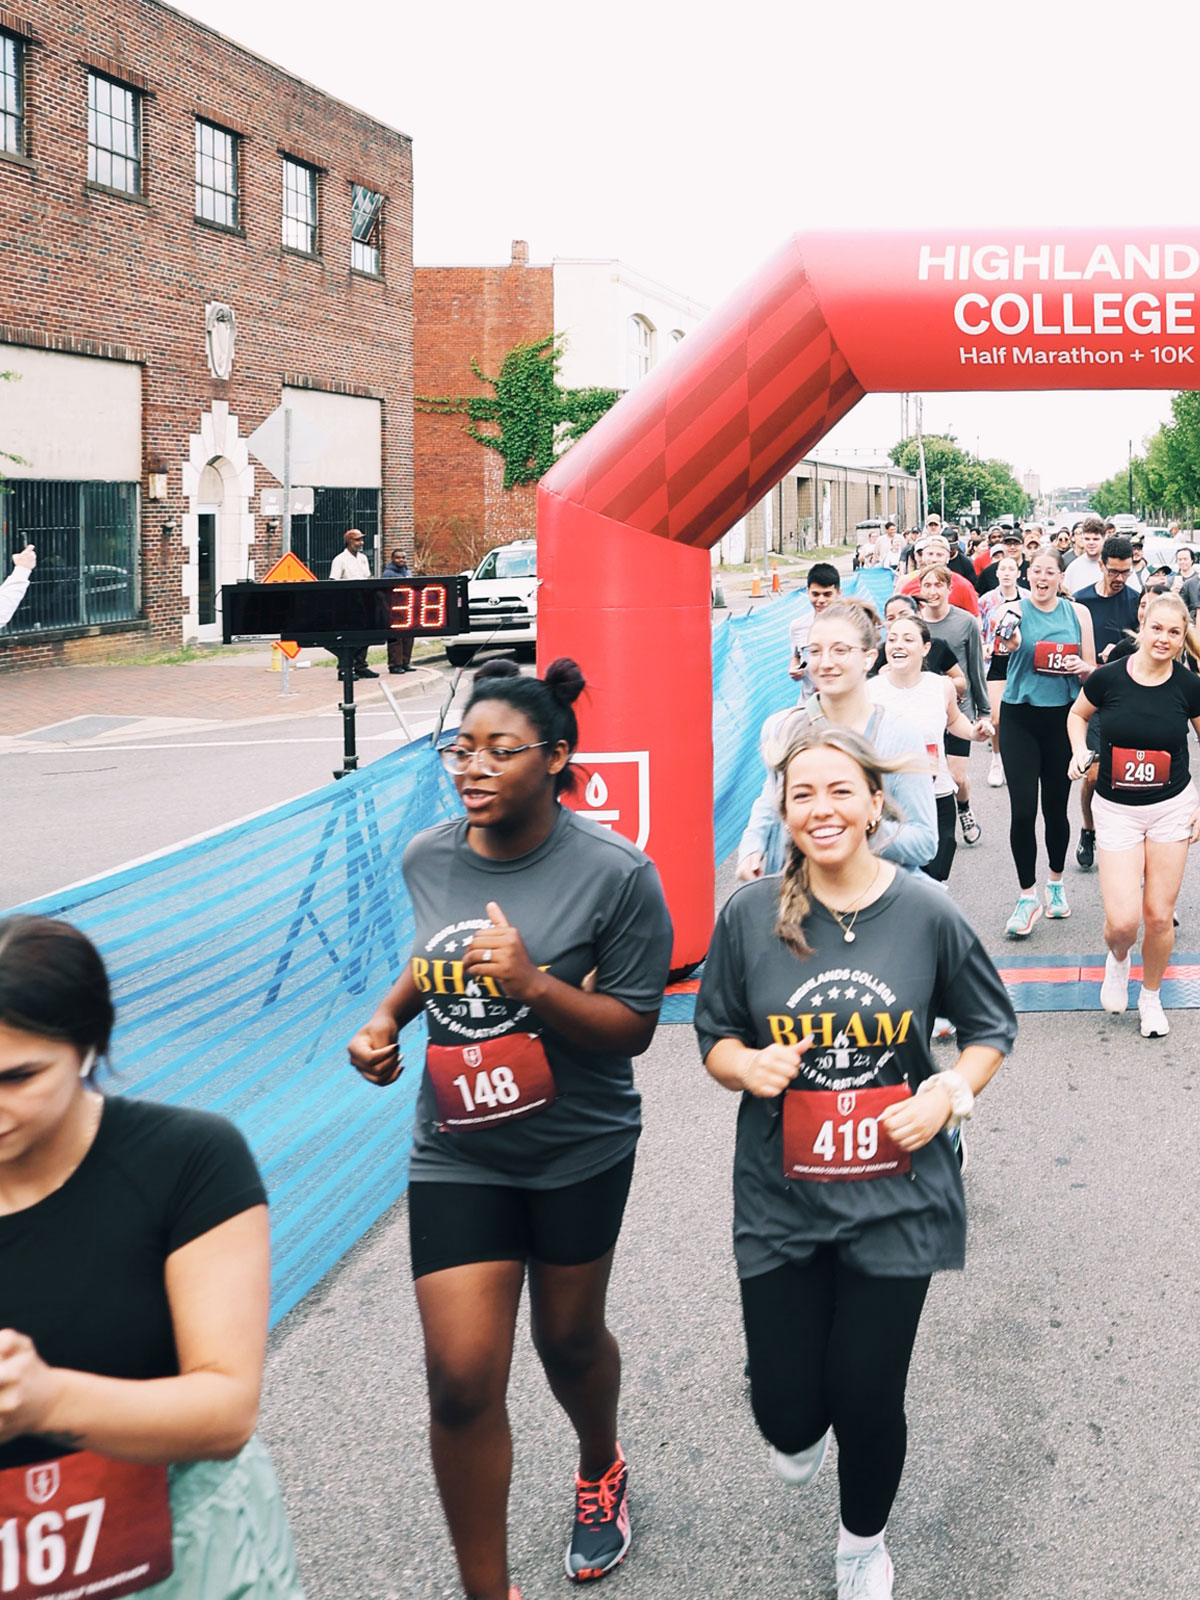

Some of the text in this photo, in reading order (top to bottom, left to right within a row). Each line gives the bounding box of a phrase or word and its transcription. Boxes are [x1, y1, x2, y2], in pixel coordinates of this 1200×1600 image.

[954, 292, 1195, 335] COLLEGE
[959, 345, 1195, 365] Half Marathon + 10K
[391, 584, 446, 629] 38
[1124, 761, 1156, 782] 249
[766, 1010, 914, 1049] BHAM
[453, 1066, 520, 1112] 148
[812, 1117, 879, 1162] 419
[0, 1498, 105, 1592] 167
